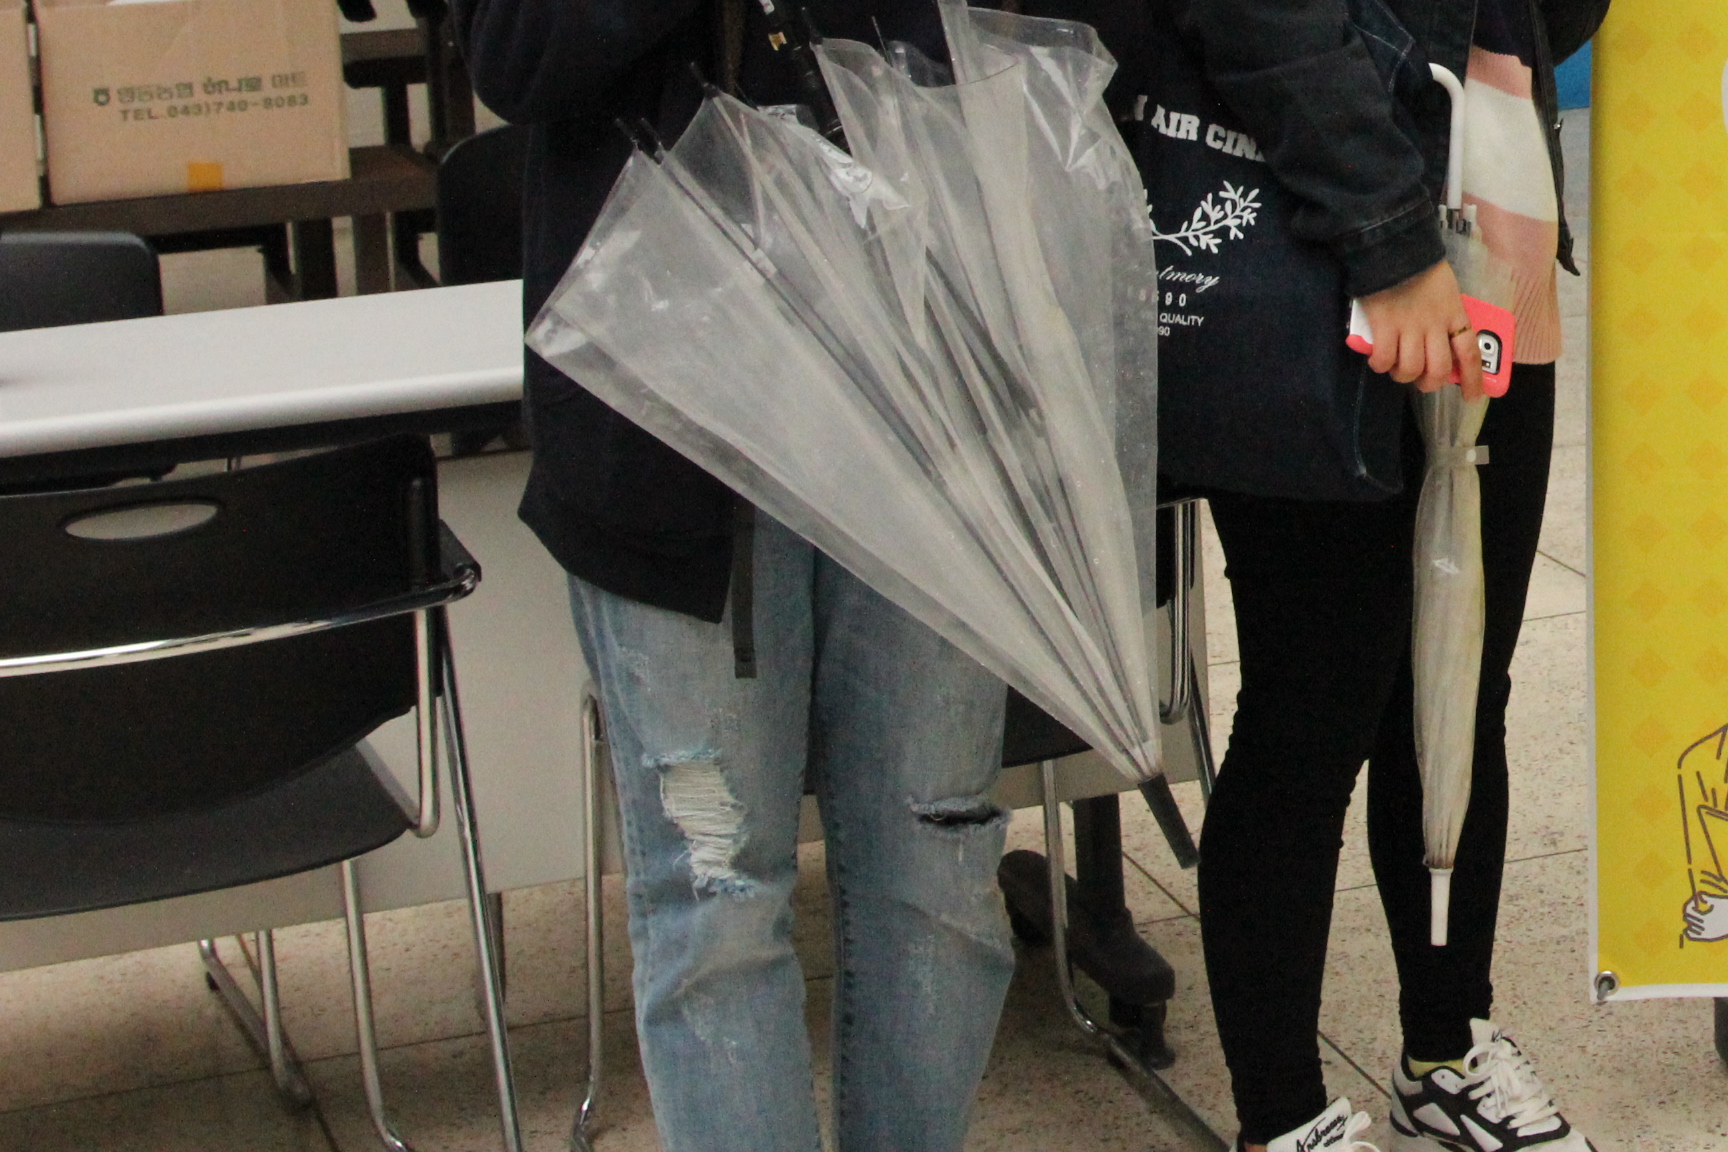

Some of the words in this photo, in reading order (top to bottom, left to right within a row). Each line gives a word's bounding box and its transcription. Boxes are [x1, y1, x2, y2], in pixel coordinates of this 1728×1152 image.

[1150, 103, 1201, 142] AIR
[1205, 122, 1266, 163] CIN
[1159, 312, 1205, 327] QUALITY
